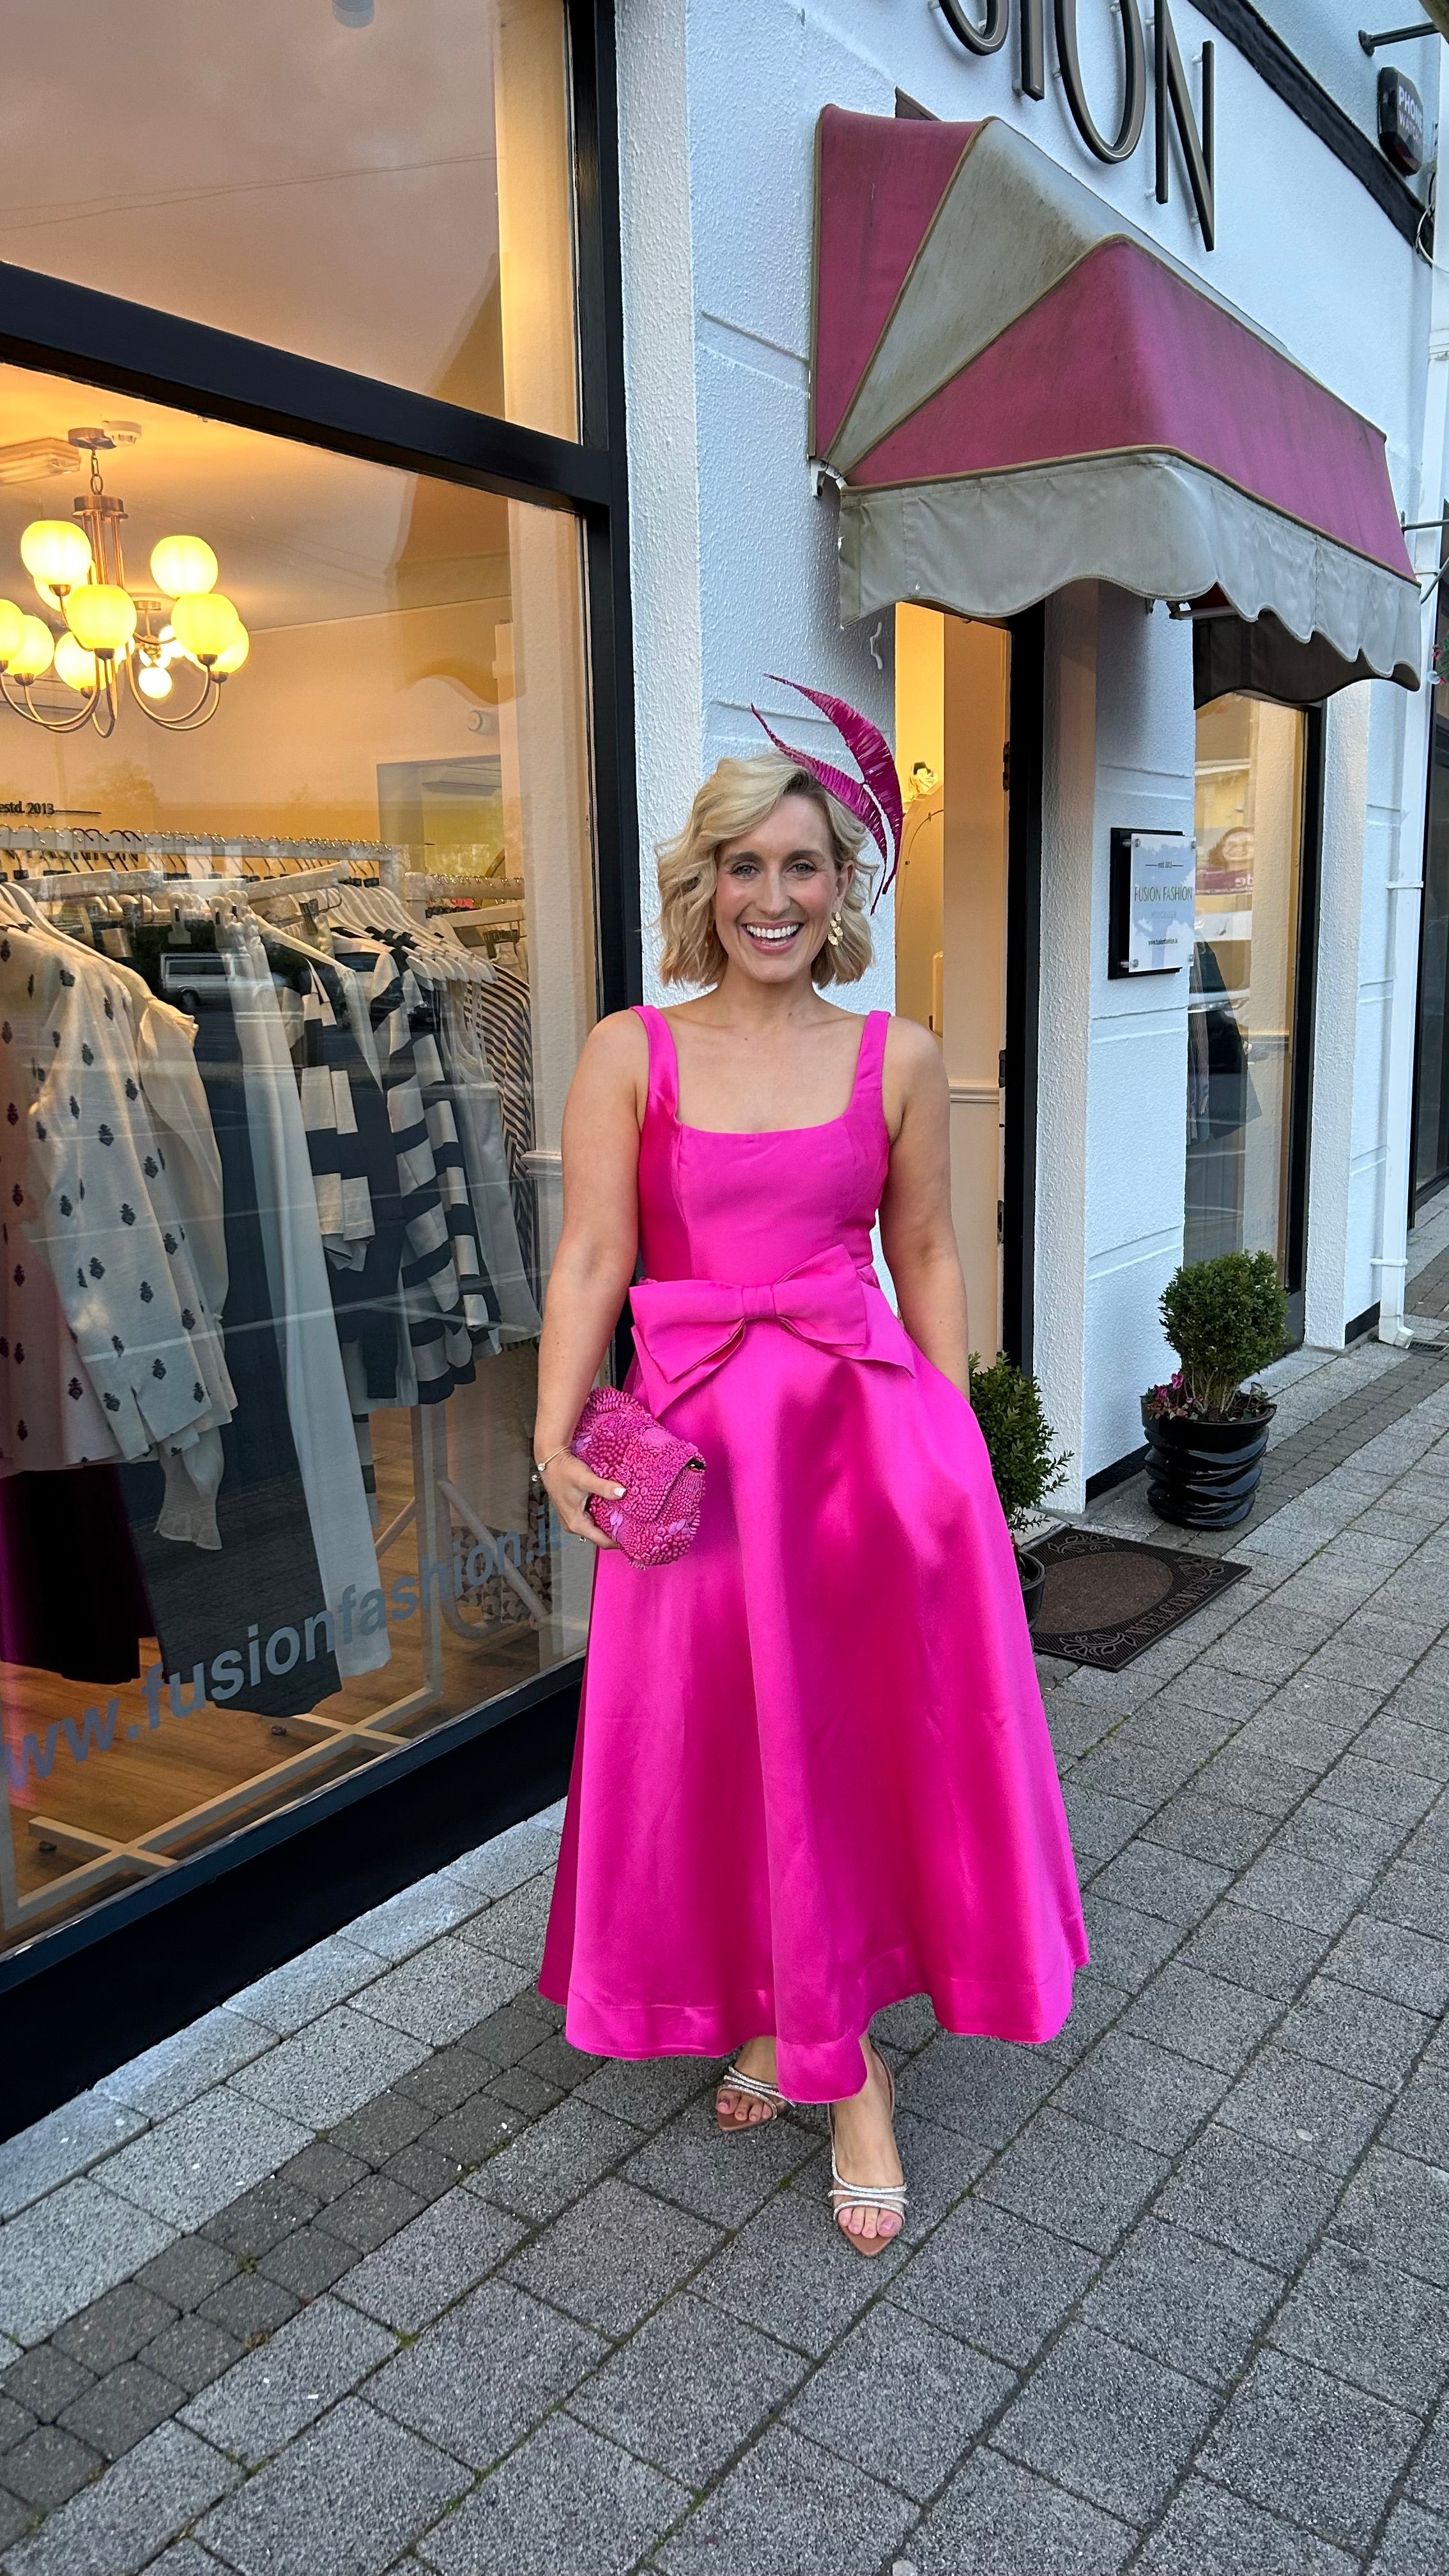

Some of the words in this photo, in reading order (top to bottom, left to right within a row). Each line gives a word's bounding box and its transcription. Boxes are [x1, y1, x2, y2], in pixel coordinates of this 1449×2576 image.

[939, 0, 1215, 252] ON
[26, 802, 55, 815] 2013
[1134, 886, 1161, 902] FUSION
[1163, 885, 1193, 901] FASHION
[1124, 1582, 1213, 1636] WELCOME
